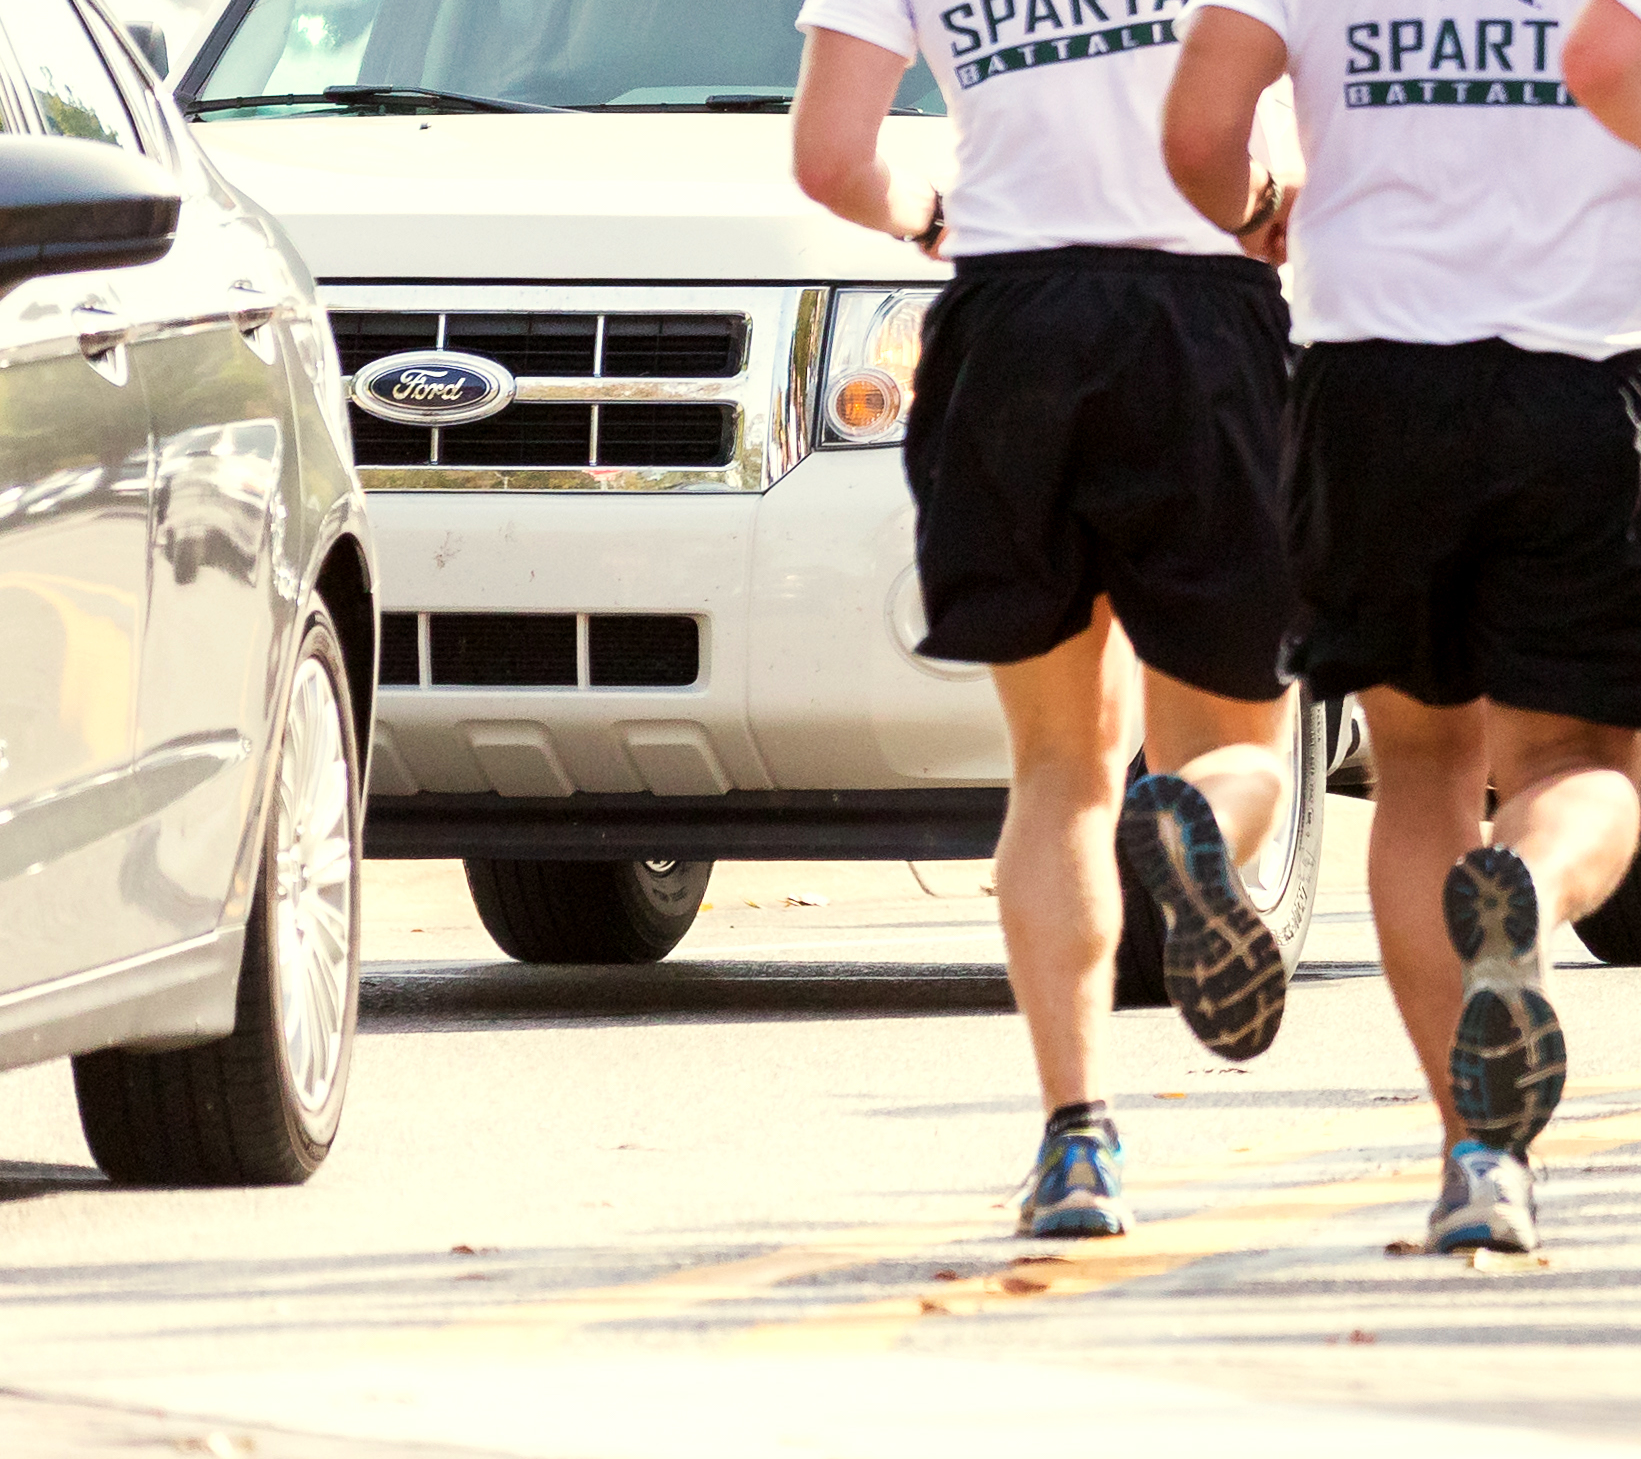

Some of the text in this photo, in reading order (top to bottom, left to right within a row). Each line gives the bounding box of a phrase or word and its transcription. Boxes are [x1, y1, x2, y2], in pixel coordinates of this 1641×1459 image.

[955, 19, 1176, 89] BATTALI
[1346, 18, 1560, 75] SPART
[1345, 80, 1574, 108] BATTALI
[392, 369, 466, 401] Ford
